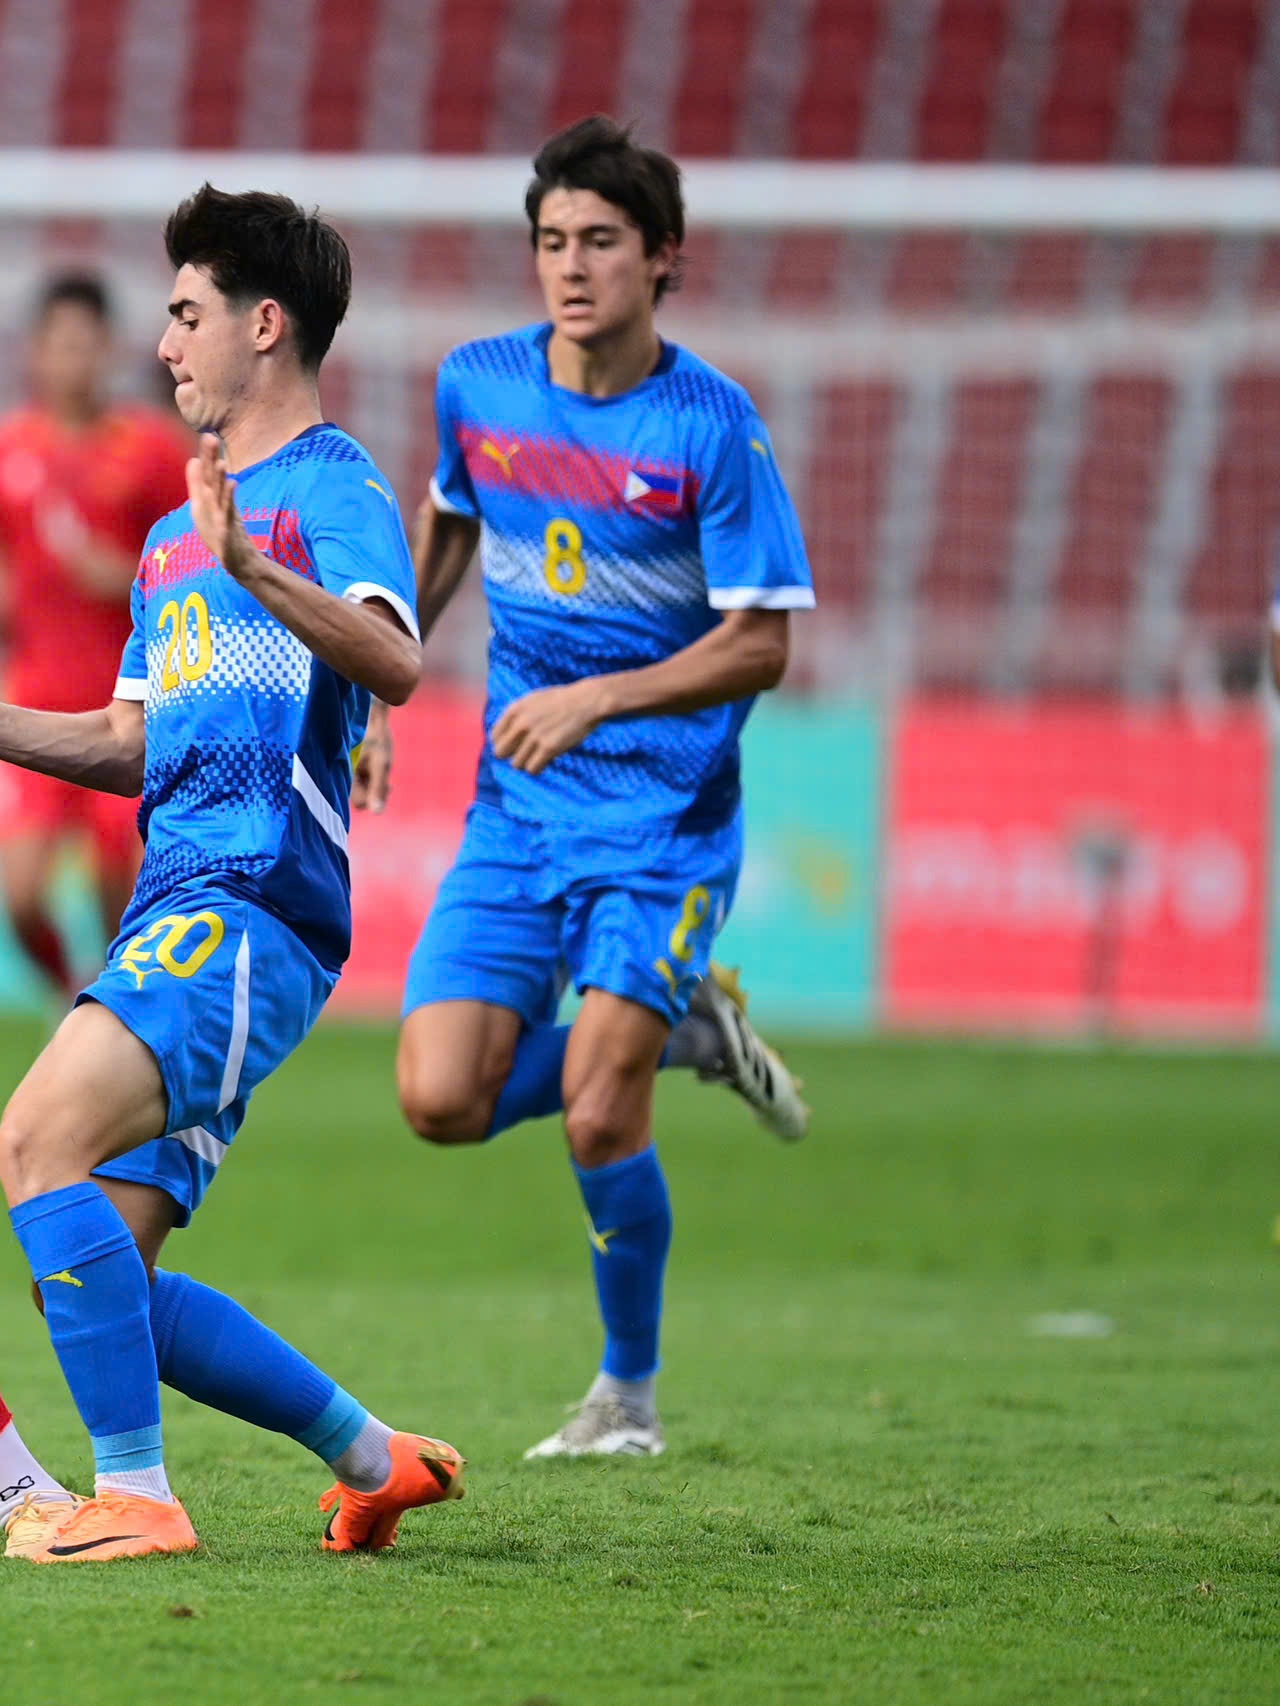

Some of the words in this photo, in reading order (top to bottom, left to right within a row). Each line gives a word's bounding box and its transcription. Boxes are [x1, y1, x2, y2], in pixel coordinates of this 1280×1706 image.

[544, 517, 587, 597] 8
[157, 591, 213, 692] 20
[120, 911, 224, 979] 20
